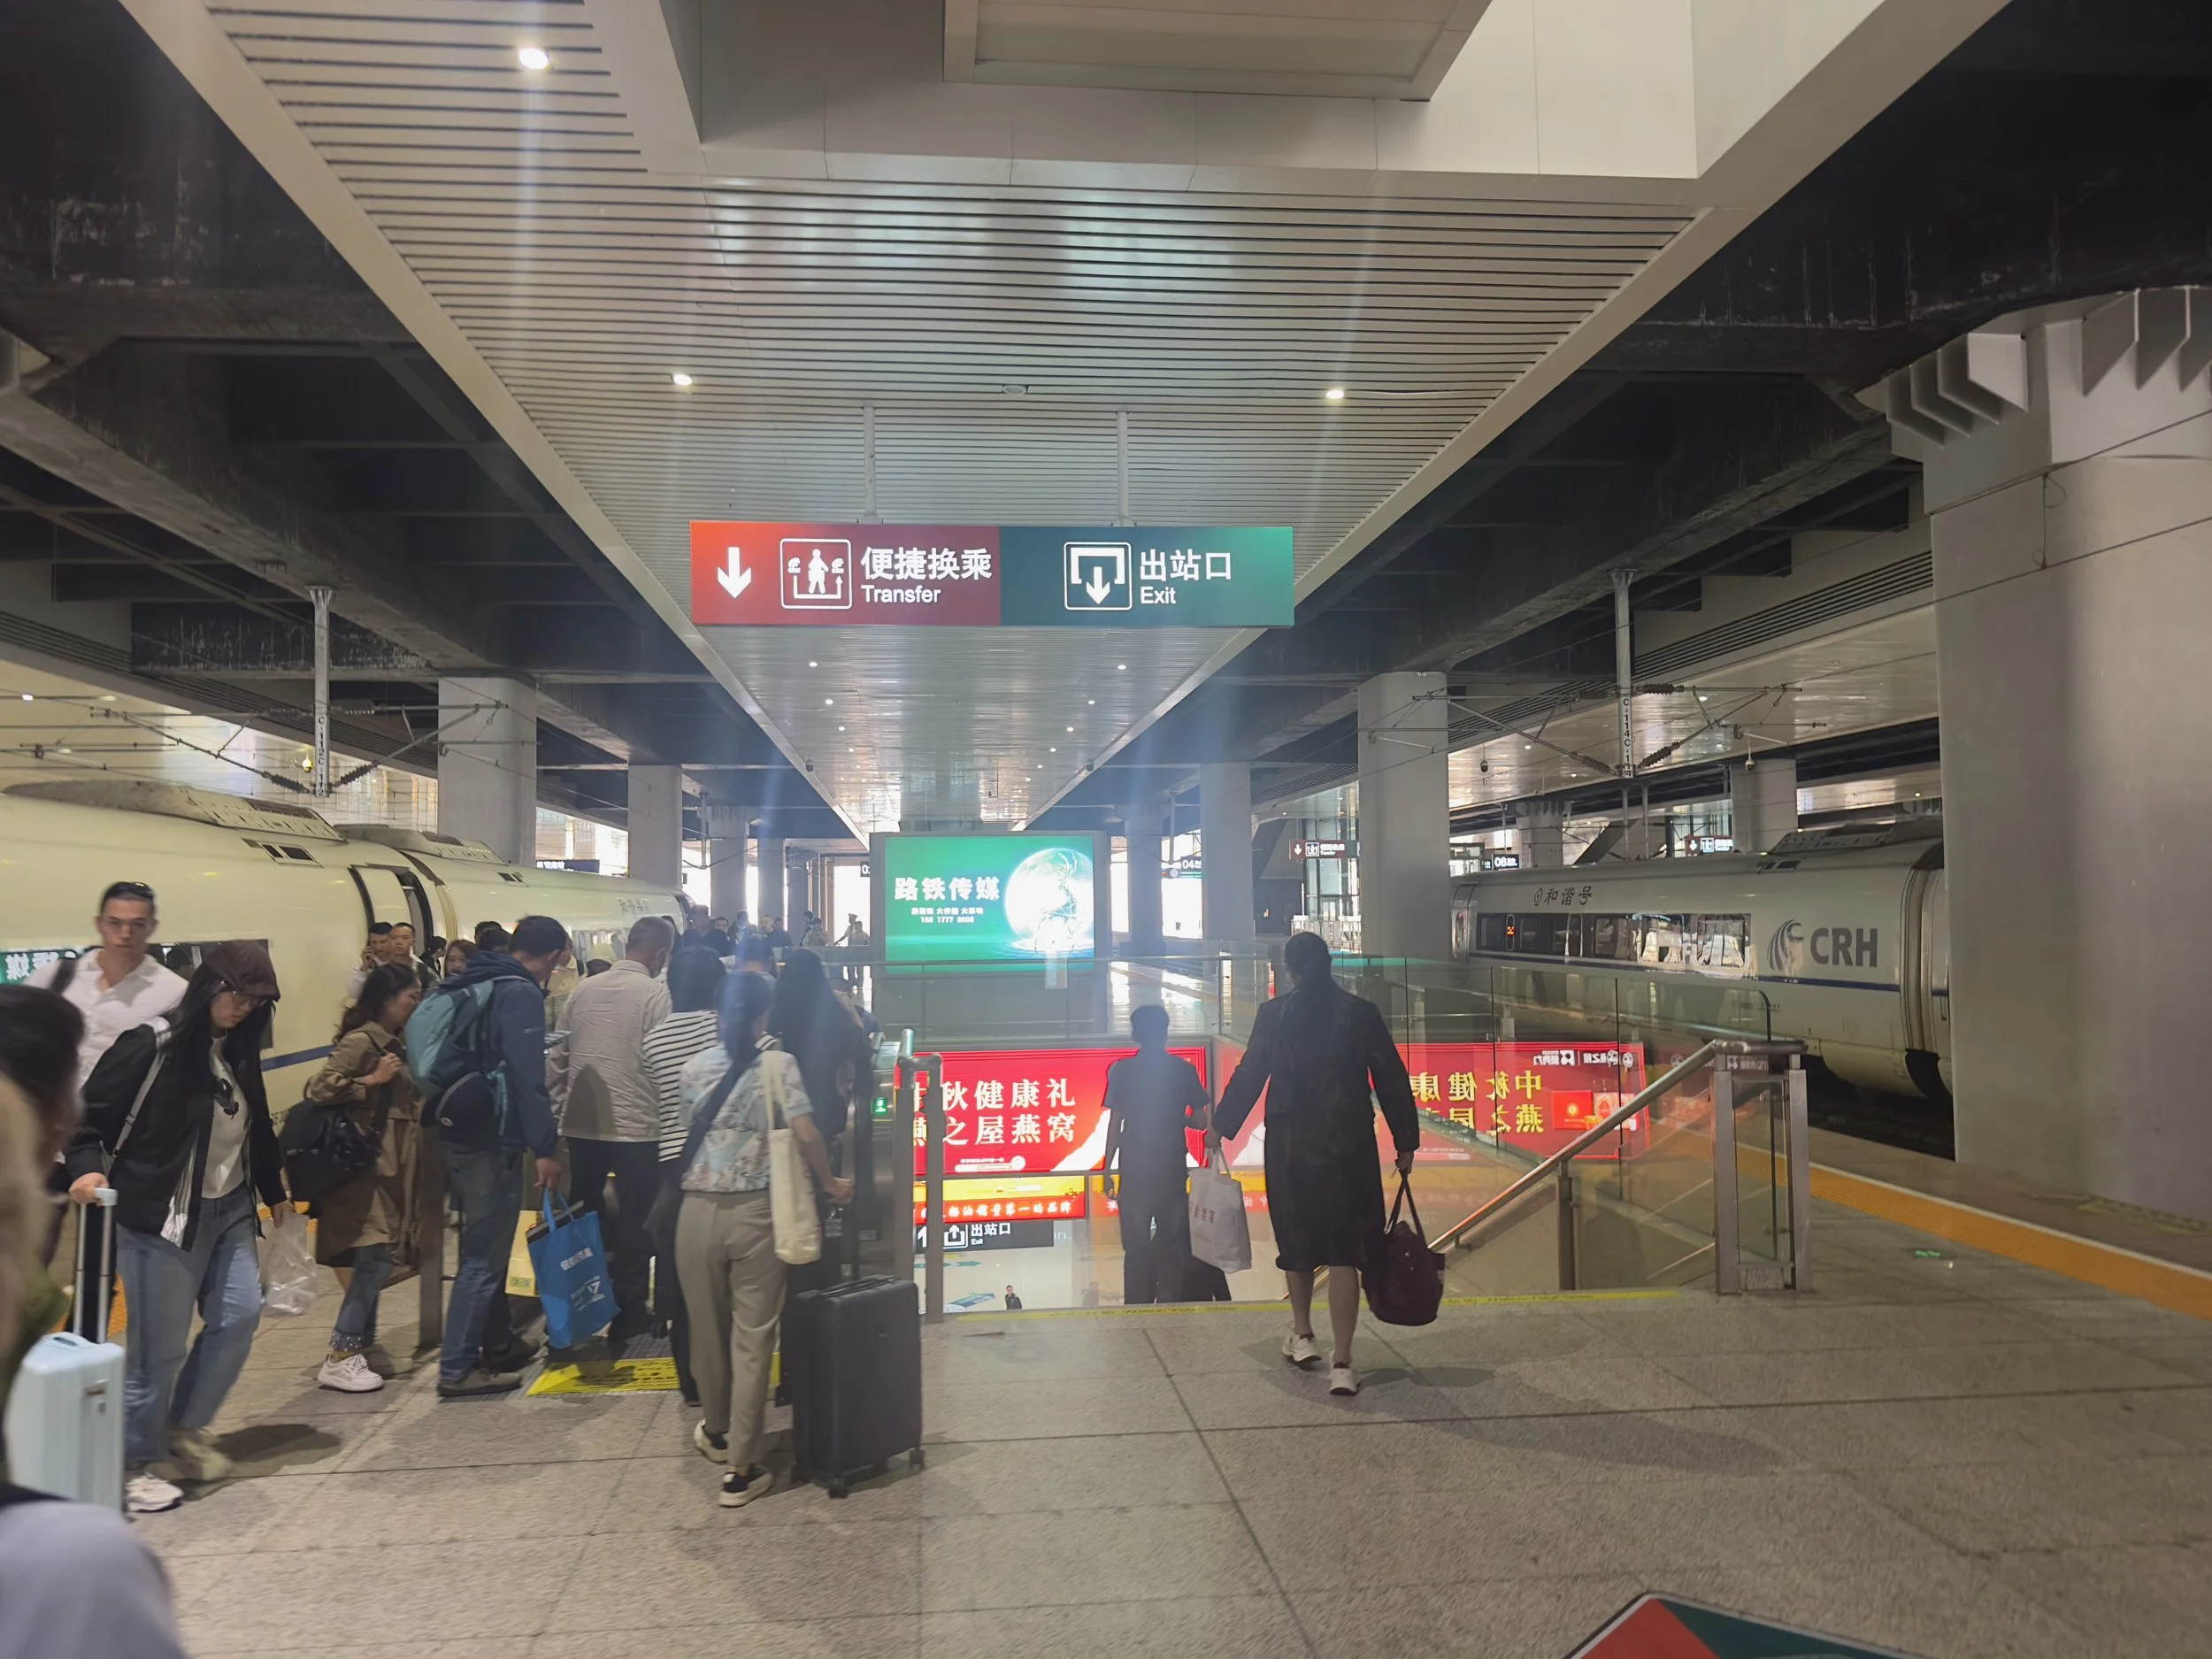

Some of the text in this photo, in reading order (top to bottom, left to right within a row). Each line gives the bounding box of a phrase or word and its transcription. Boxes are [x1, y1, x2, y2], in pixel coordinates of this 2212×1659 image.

[861, 546, 992, 580] 便捷换乘
[1141, 549, 1231, 581] 出站口
[861, 585, 941, 603] Transfer
[1141, 587, 1176, 603] Exit
[895, 877, 1000, 901] 路铁传媒
[1544, 886, 1593, 906] 和谐号
[1811, 928, 1878, 968] CRH
[971, 1222, 1011, 1237] 出站口
